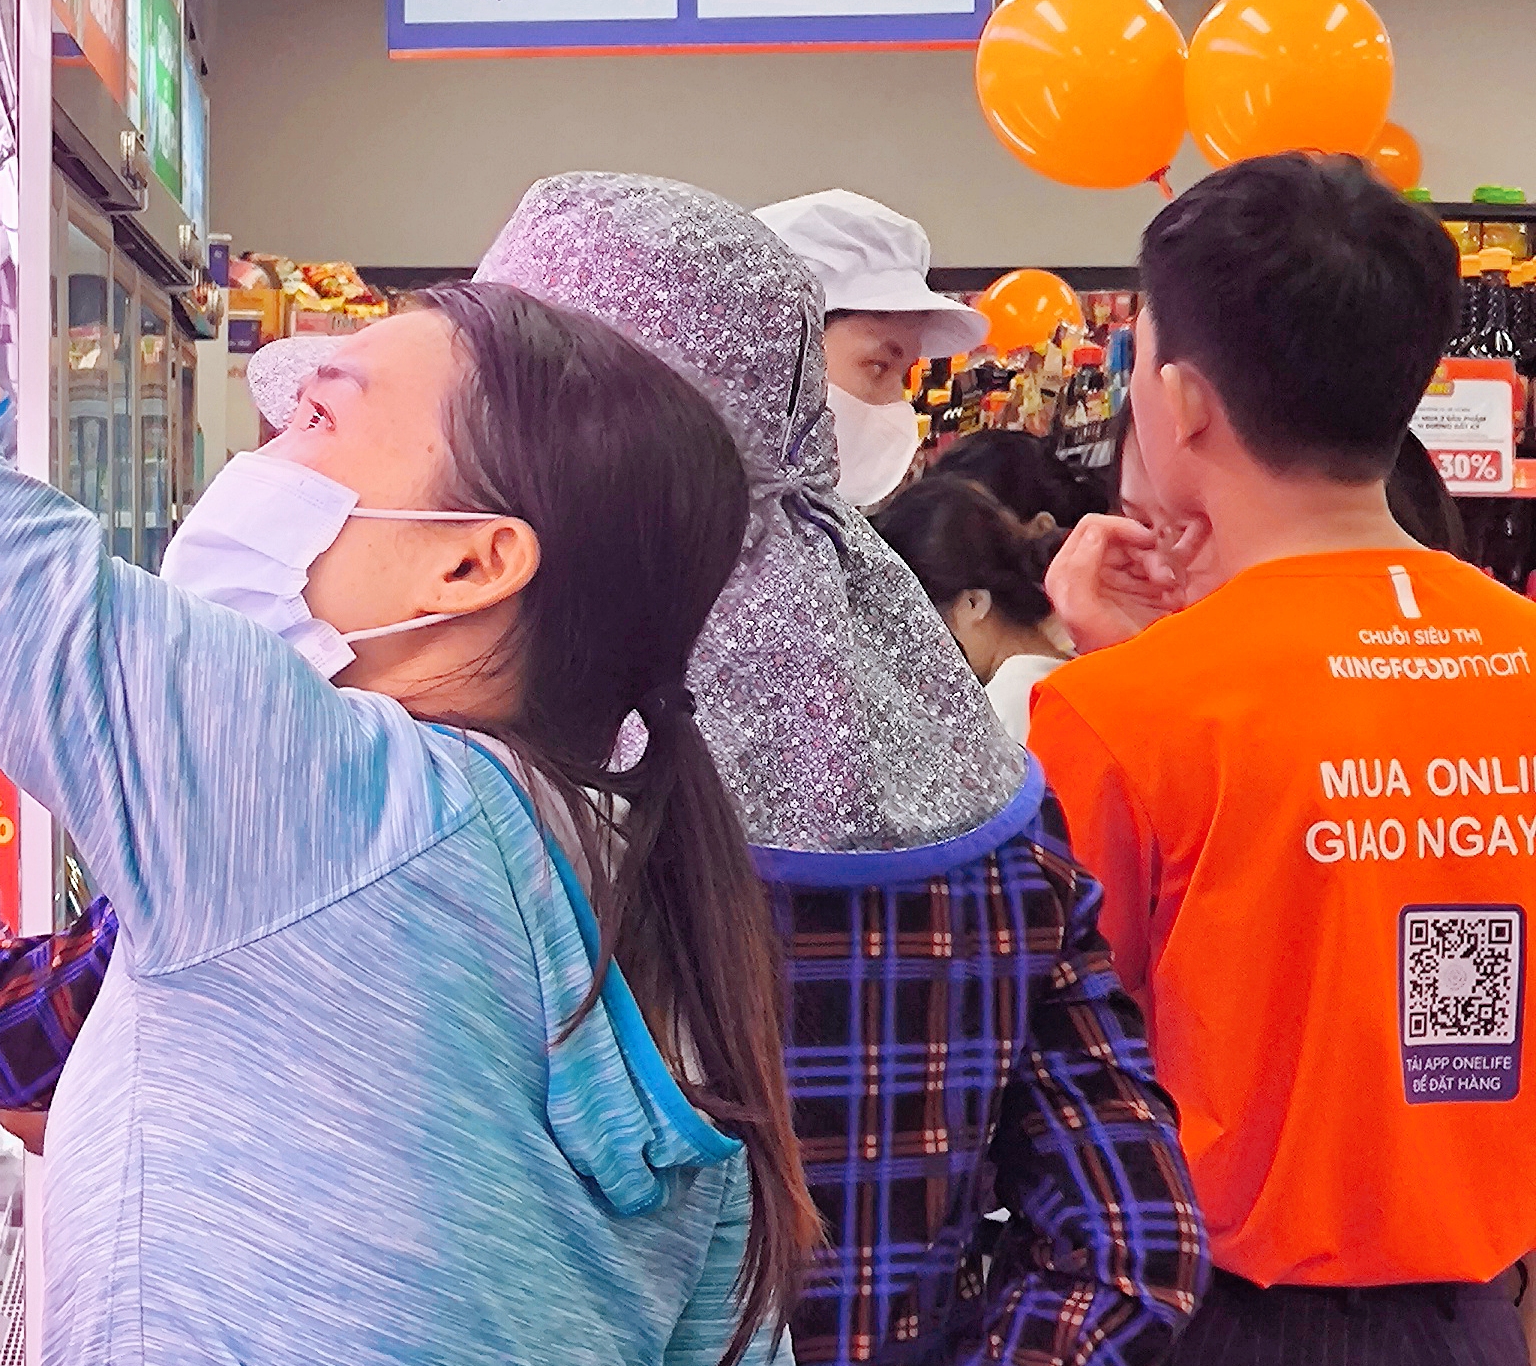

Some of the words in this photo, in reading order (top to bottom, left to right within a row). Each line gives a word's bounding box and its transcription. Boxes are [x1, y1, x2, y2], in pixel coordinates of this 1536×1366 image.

[1438, 452, 1498, 480] 30%
[1415, 626, 1451, 646] SIÊU
[1319, 757, 1412, 800] MUA
[1425, 754, 1536, 797] ONLI
[1305, 818, 1407, 864] GIAO
[1416, 814, 1536, 860] NGAY
[1424, 1056, 1450, 1072] APP
[1452, 1055, 1513, 1071] ONELIFE
[1457, 1073, 1502, 1091] HÀNG
